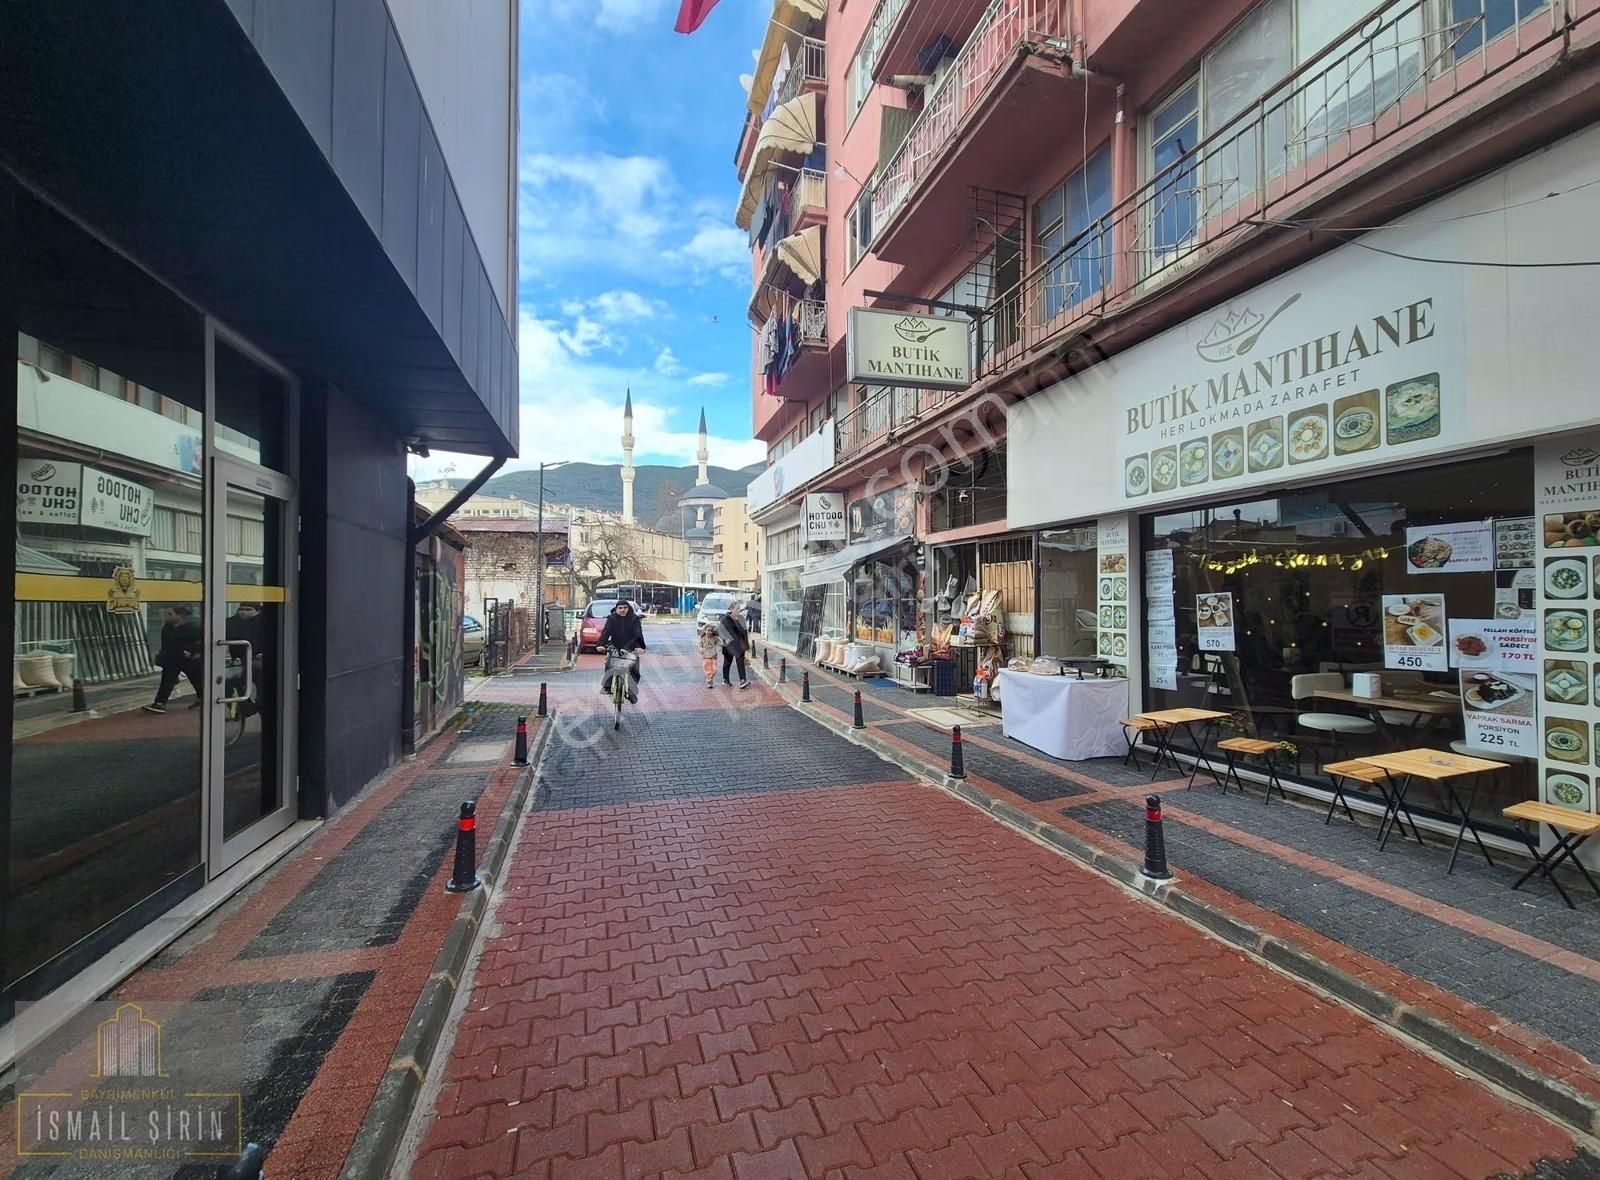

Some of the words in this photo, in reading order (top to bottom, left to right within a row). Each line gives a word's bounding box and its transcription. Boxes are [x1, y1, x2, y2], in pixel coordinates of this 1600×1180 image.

[892, 345, 940, 362] BUTİK
[868, 359, 964, 380] MANTIHANE
[1126, 384, 1200, 435] BUTİK
[1206, 297, 1436, 410] MANTIHANE
[1160, 421, 1186, 440] HER
[1189, 398, 1264, 431] LOKMADA
[1270, 367, 1361, 408] ZARAFET
[1565, 463, 1600, 480] BUTİ
[808, 511, 844, 521] HOTDOG
[809, 521, 826, 530] CHU
[1206, 639, 1221, 648] 570
[1397, 656, 1423, 667] 450
[1522, 653, 1536, 661] TL
[1500, 717, 1533, 727] SARMA
[1478, 723, 1520, 735] PORSİYON
[1480, 732, 1505, 745] 225
[1508, 740, 1520, 748] TL
